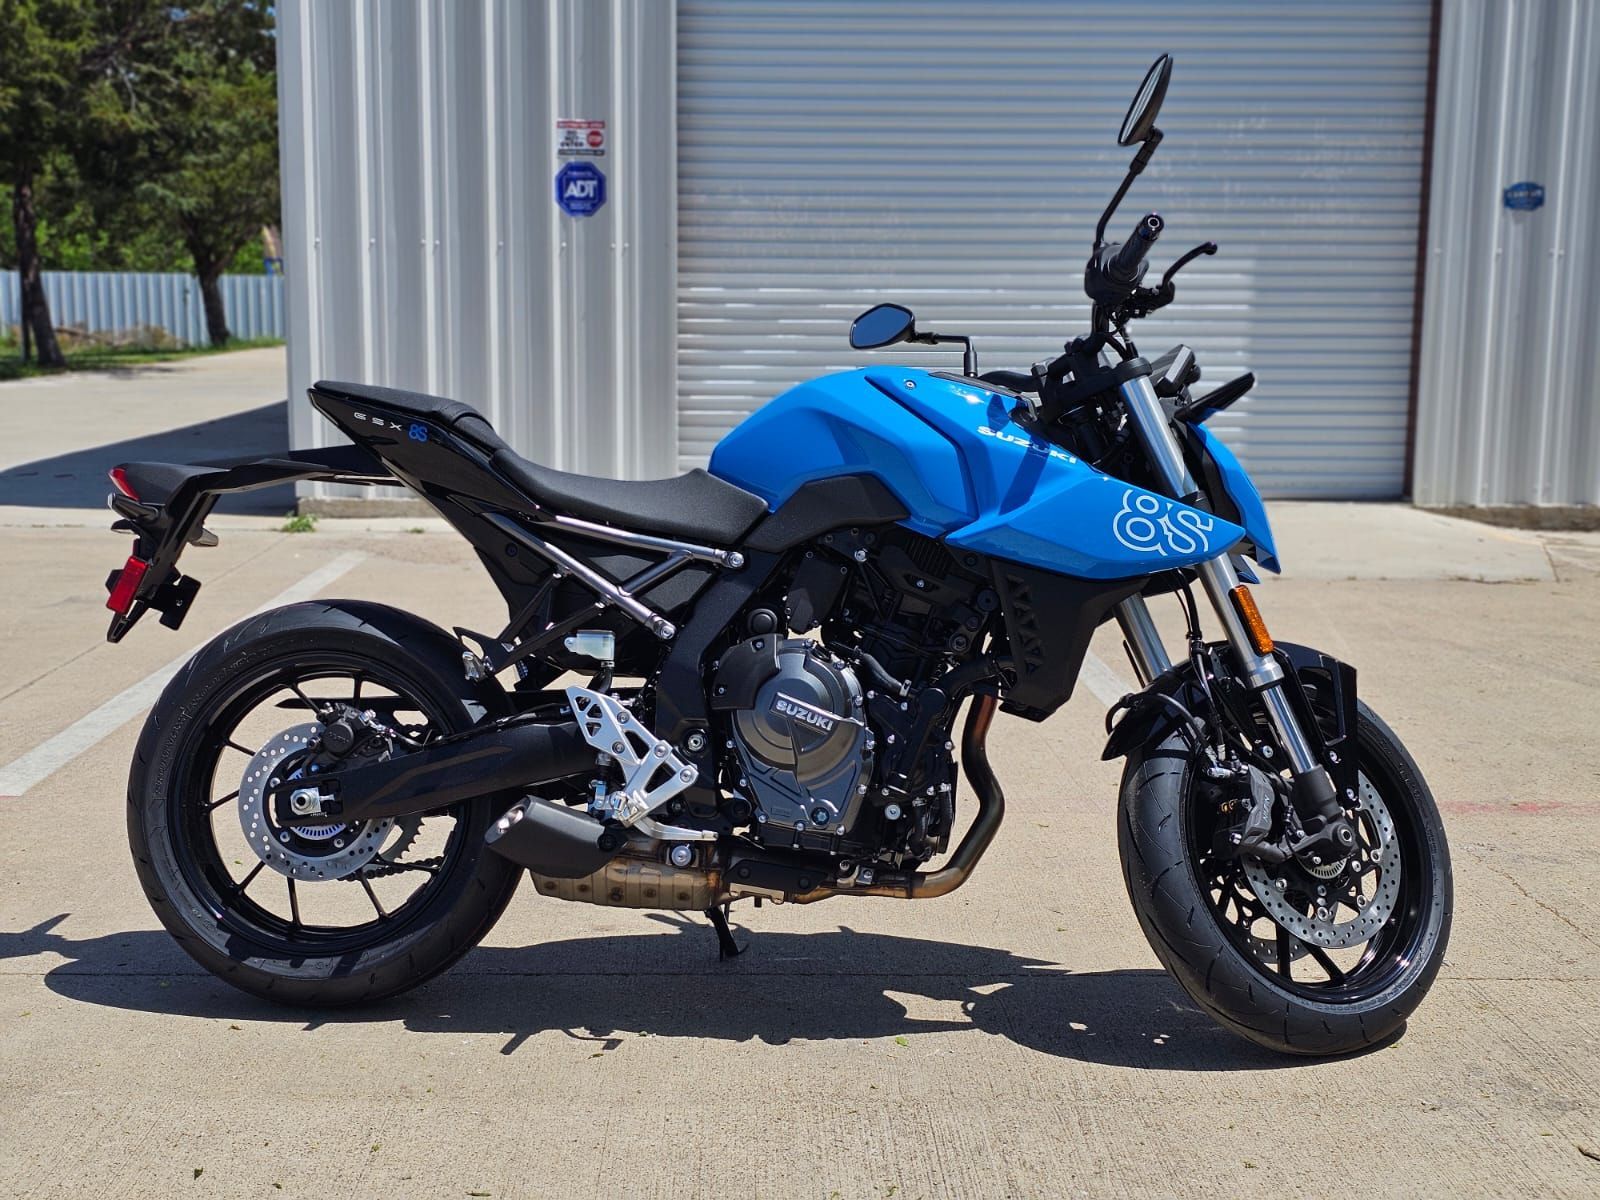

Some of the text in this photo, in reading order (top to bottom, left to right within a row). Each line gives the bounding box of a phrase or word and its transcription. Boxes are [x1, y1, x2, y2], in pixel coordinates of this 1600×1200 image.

[563, 180, 598, 198] ADT
[976, 426, 1077, 464] SUZUKI
[775, 699, 834, 732] SUZUKI
